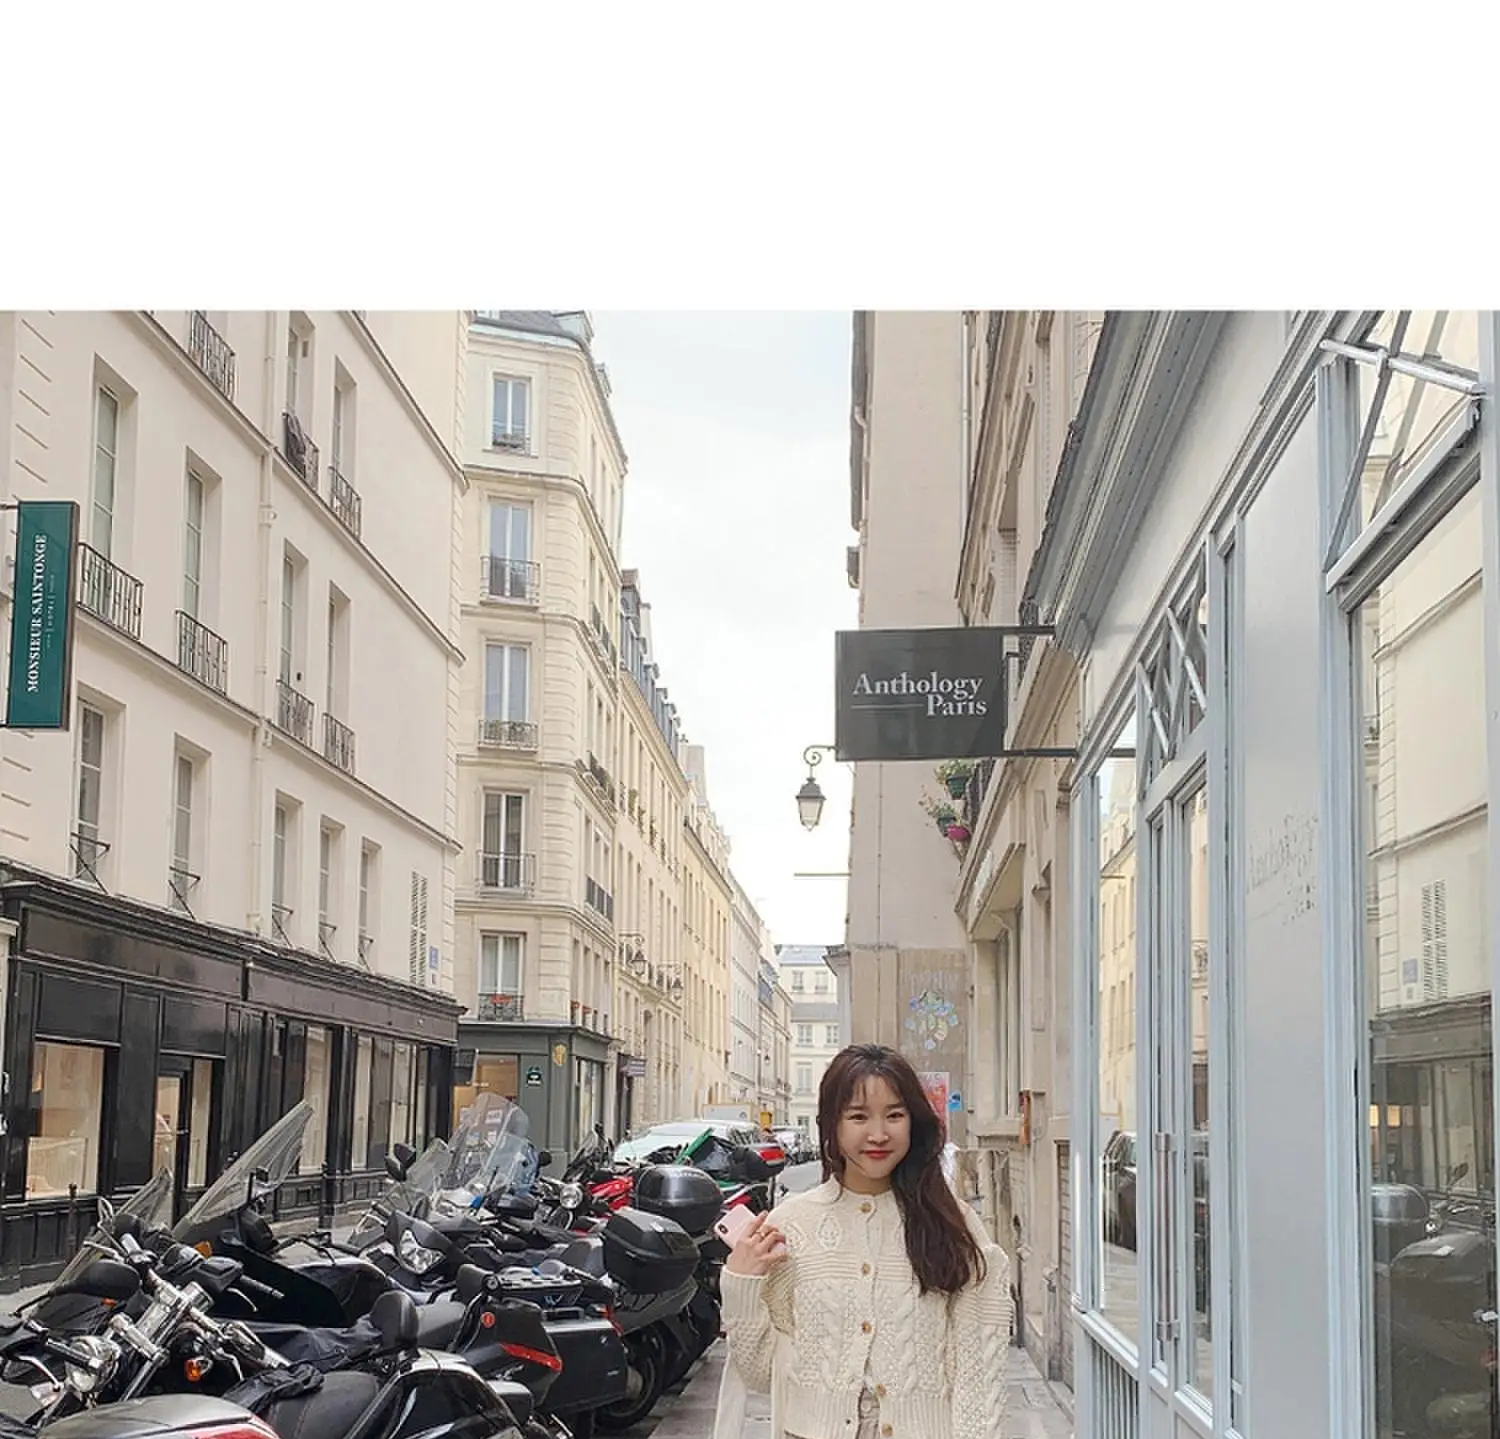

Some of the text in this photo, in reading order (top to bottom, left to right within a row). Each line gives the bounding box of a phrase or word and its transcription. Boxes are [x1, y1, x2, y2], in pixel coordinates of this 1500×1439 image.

[27, 535, 47, 692] MONSIEUR SAINTONGE
[853, 672, 983, 700] Anthology
[926, 693, 988, 716] Paris
